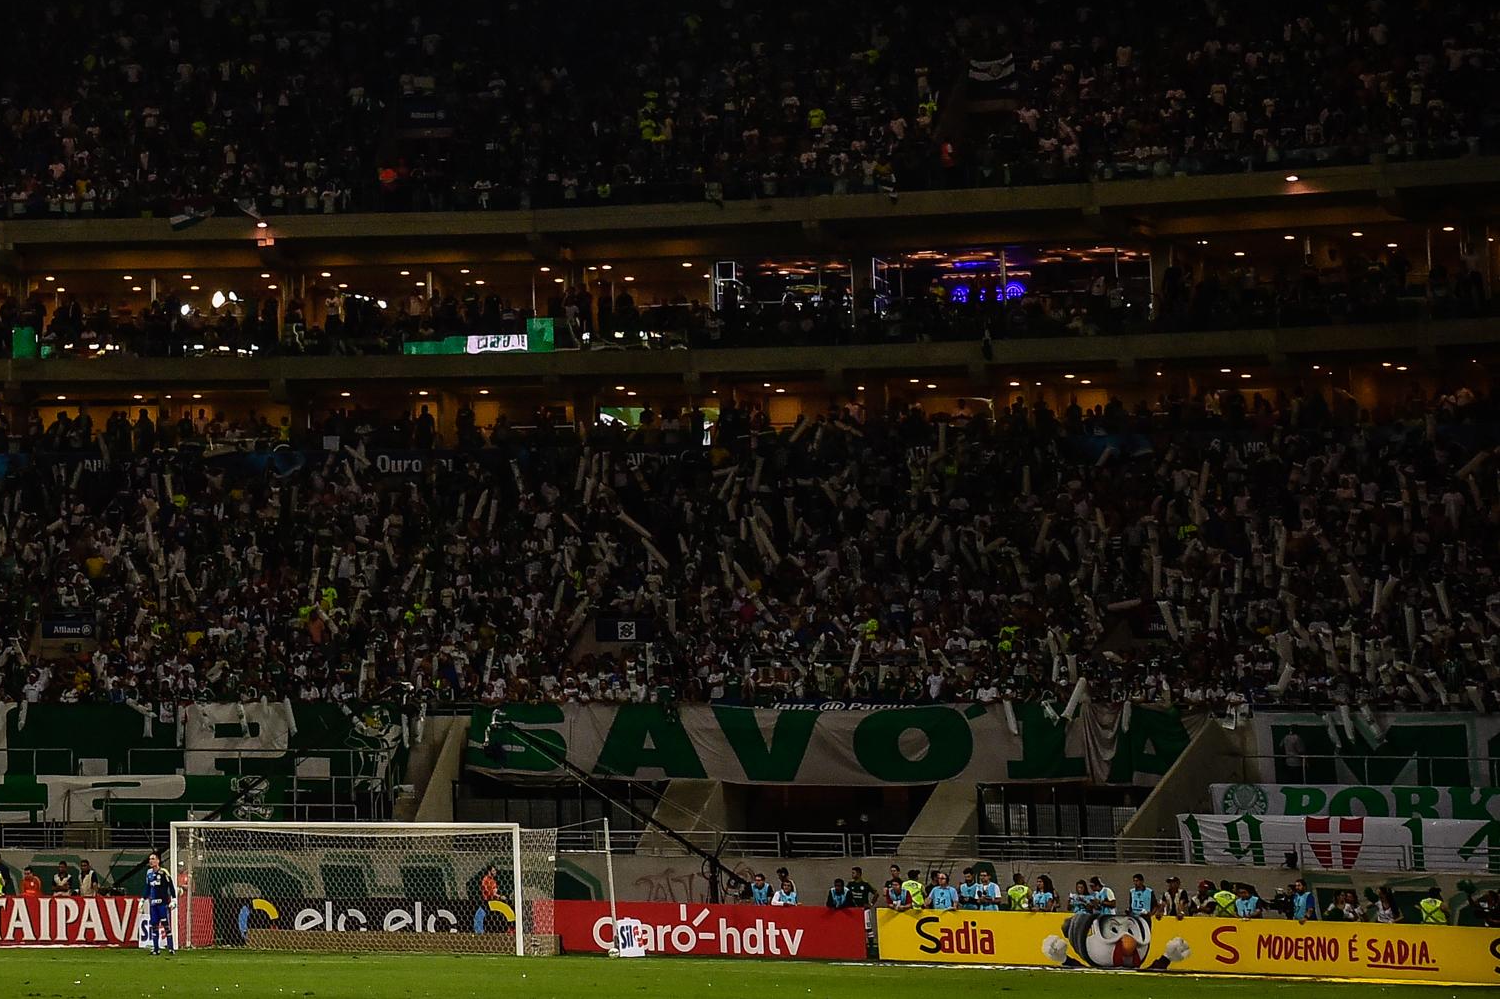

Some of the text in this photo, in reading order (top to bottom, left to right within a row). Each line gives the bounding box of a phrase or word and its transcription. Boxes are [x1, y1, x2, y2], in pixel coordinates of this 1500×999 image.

[53, 625, 81, 635] Allianz
[1133, 899, 1145, 909] 15
[916, 916, 995, 955] Sadia
[1211, 926, 1240, 964] S
[1256, 934, 1437, 965] MODERNO É SADIA.
